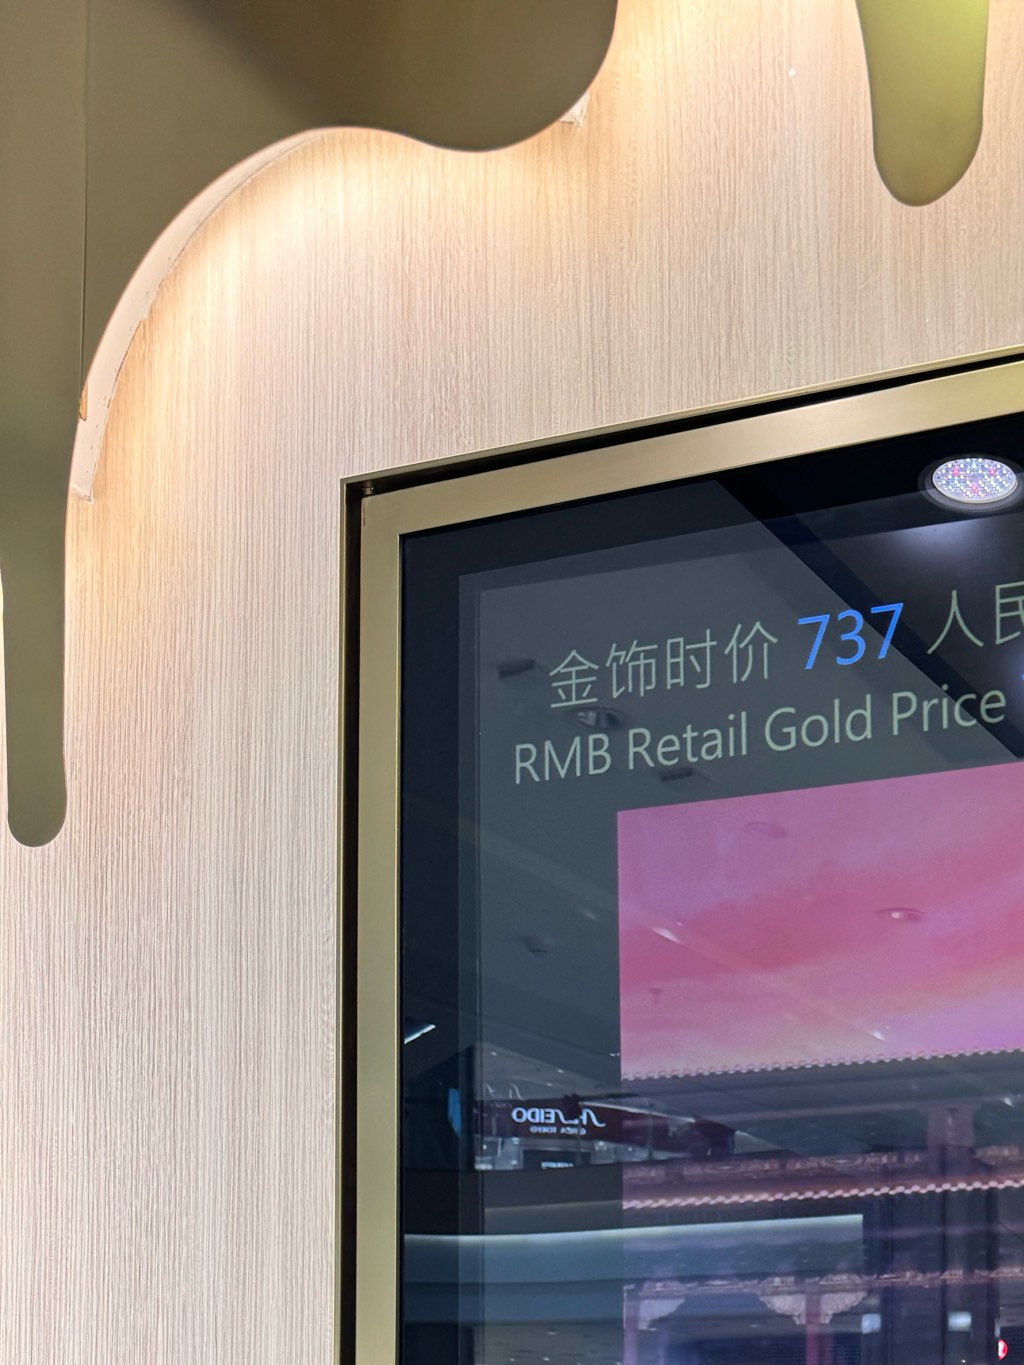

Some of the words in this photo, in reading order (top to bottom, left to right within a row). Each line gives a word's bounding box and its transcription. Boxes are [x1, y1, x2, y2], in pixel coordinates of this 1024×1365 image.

[549, 620, 778, 708] 金饰时价
[797, 603, 904, 669] 737
[515, 733, 612, 784] RMB
[628, 711, 749, 770] Retail
[764, 694, 873, 752] Gold
[892, 683, 1006, 735] Price
